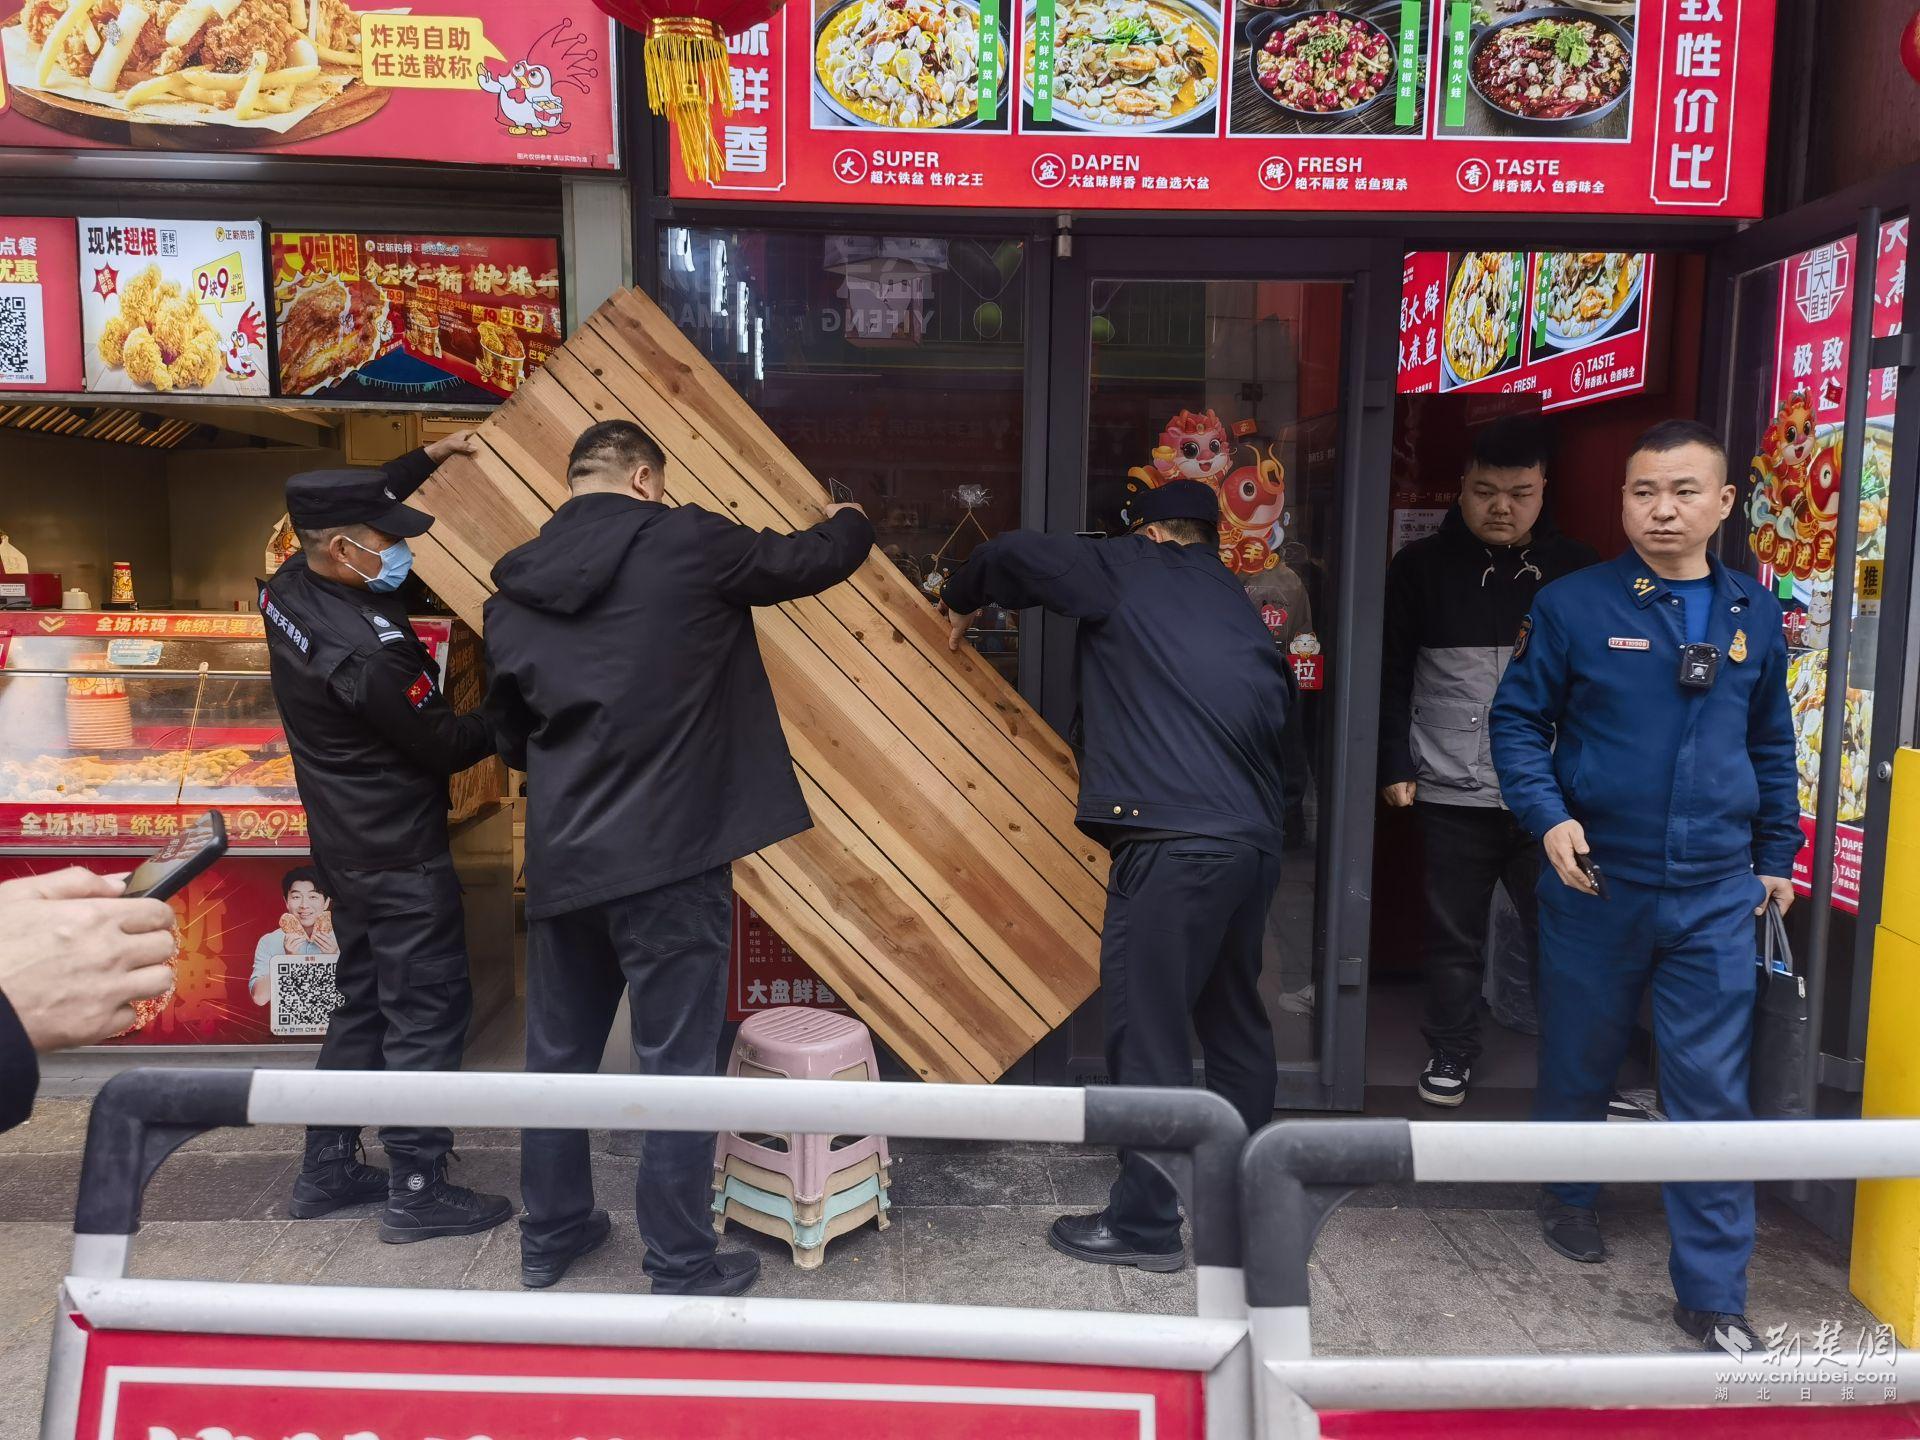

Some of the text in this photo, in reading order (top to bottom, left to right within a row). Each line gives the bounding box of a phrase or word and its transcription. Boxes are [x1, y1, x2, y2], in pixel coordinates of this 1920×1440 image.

[370, 24, 471, 51] 炸鸡自助
[982, 14, 994, 99] 青柠酸菜鱼
[1038, 15, 1050, 100] 蜀大鲜水煮鱼
[371, 52, 474, 80] 任选散称
[872, 150, 939, 168] SUPER
[1071, 154, 1140, 171] DAPEN
[1298, 157, 1362, 173] FRESH
[1496, 159, 1560, 176] TASTE
[870, 170, 984, 186] 超大铁盆 性价之王
[1068, 175, 1210, 190] 大盆味鲜香 吃鱼选大盆
[1295, 177, 1408, 191] 绝不隔夜 活鱼现杀
[1492, 179, 1605, 194] 鲜香诱人 色香味全
[88, 226, 158, 256] 现炸翅根
[1587, 352, 1616, 373] TASTE
[1513, 376, 1537, 393] FRESH
[1863, 566, 1878, 588] 推
[96, 616, 168, 633] 全场炸鸡
[174, 618, 248, 634] 统统只要
[1262, 609, 1283, 627] 拉
[1294, 659, 1316, 680] 拉
[20, 812, 118, 837] 全场炸鸡
